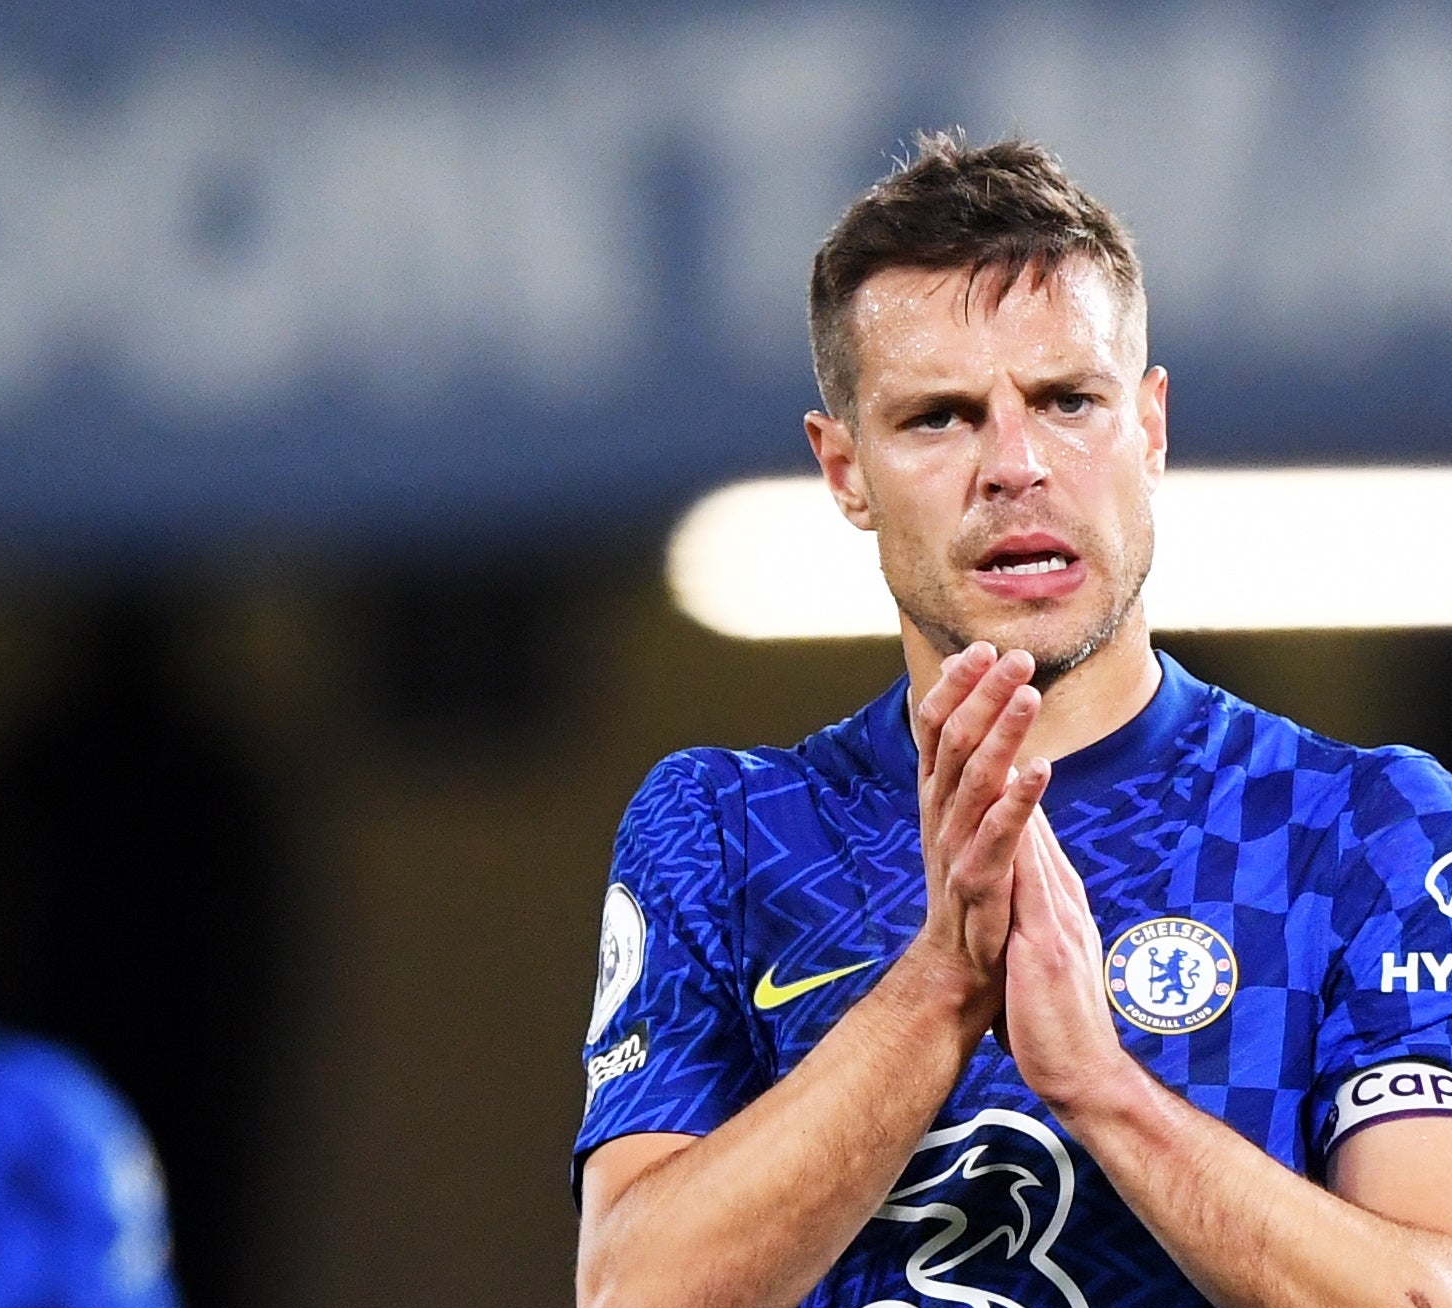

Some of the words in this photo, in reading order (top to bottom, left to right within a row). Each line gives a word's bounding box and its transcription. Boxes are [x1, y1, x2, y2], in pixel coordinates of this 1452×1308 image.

[1130, 922, 1214, 949] CHELSEA
[1125, 1004, 1181, 1028] FOOTBALL
[1184, 1006, 1213, 1026] CLUB
